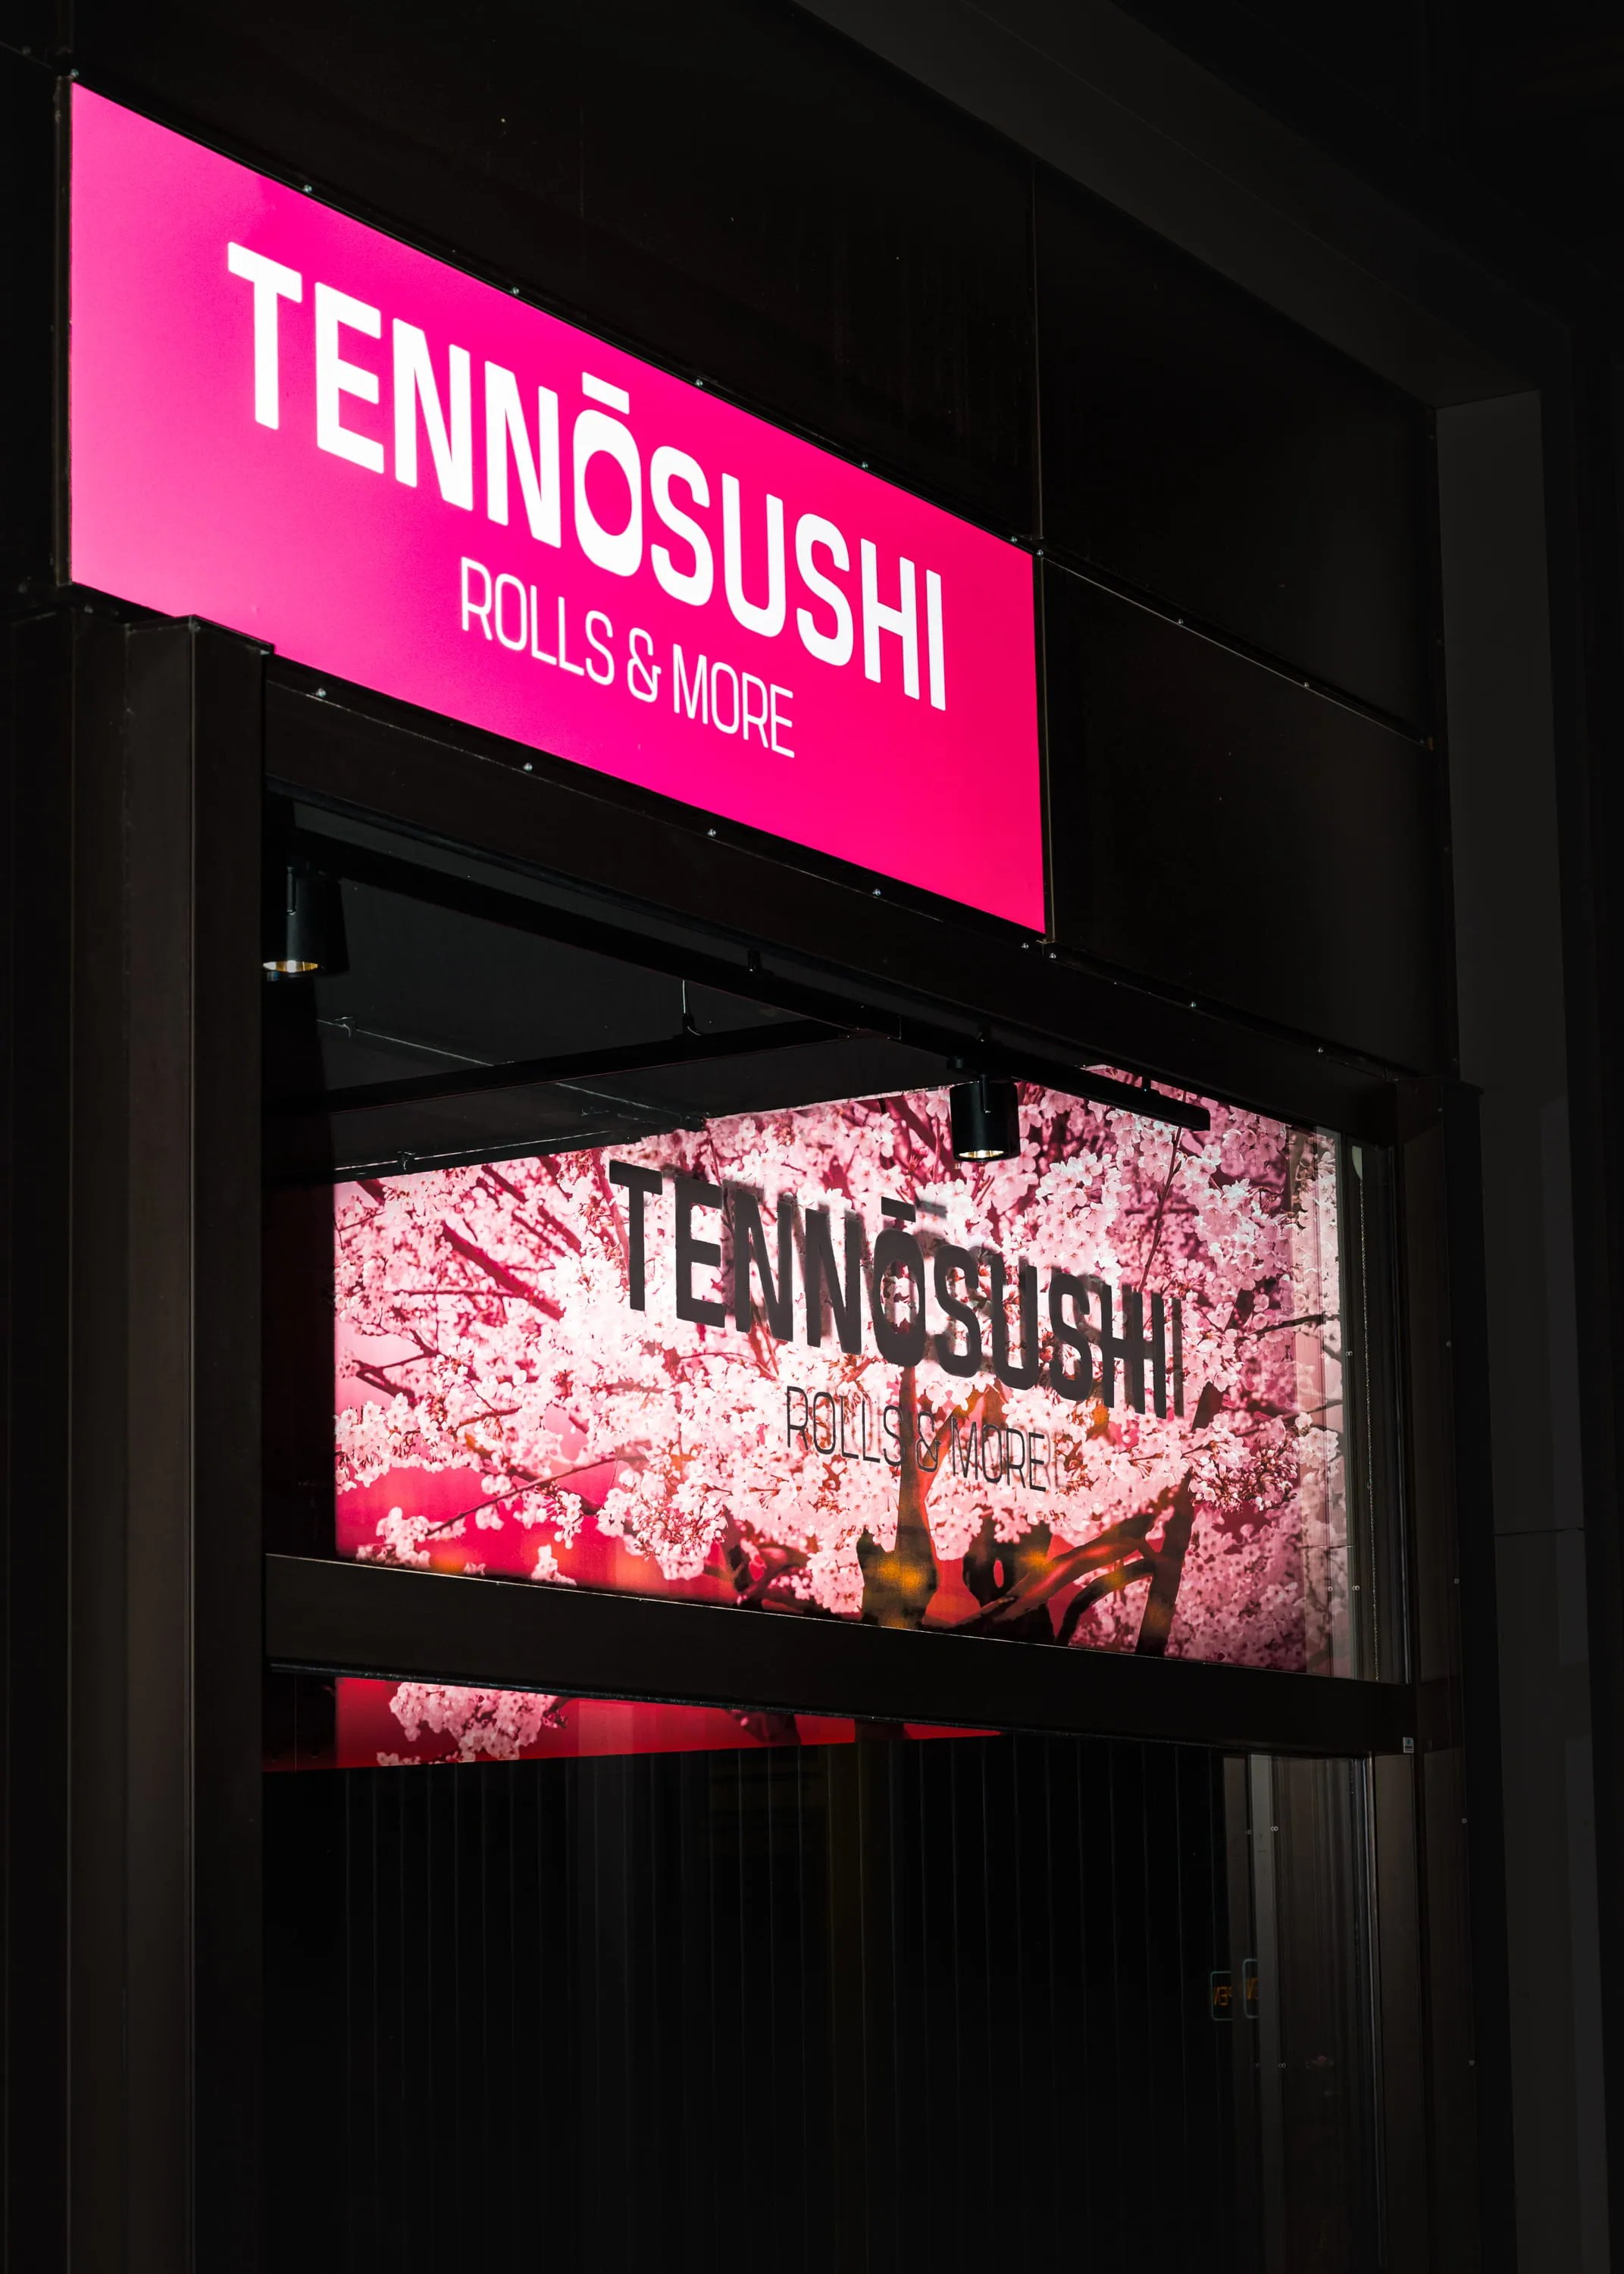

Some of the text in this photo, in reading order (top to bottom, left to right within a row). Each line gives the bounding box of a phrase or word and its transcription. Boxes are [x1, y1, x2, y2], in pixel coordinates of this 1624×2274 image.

[461, 556, 796, 758] ROLLS & MORE
[787, 1386, 1047, 1492] ROLLS & MORE
